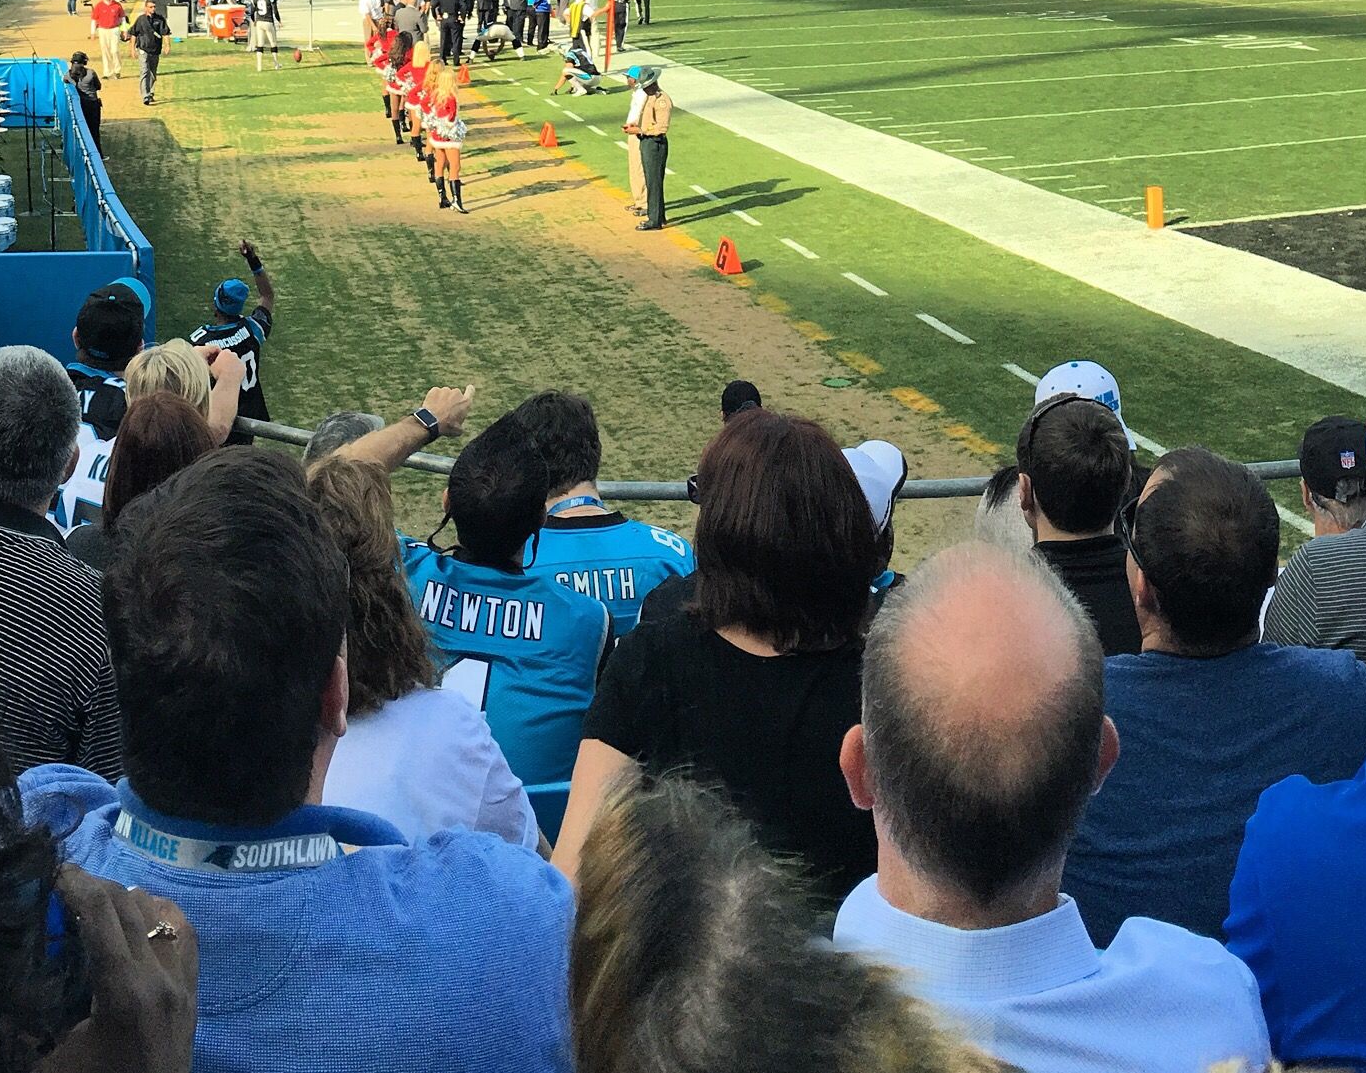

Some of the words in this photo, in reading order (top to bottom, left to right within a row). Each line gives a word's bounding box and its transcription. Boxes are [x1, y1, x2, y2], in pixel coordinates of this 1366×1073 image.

[716, 240, 729, 271] G
[554, 567, 636, 602] SMITH
[420, 579, 545, 641] NEWTON
